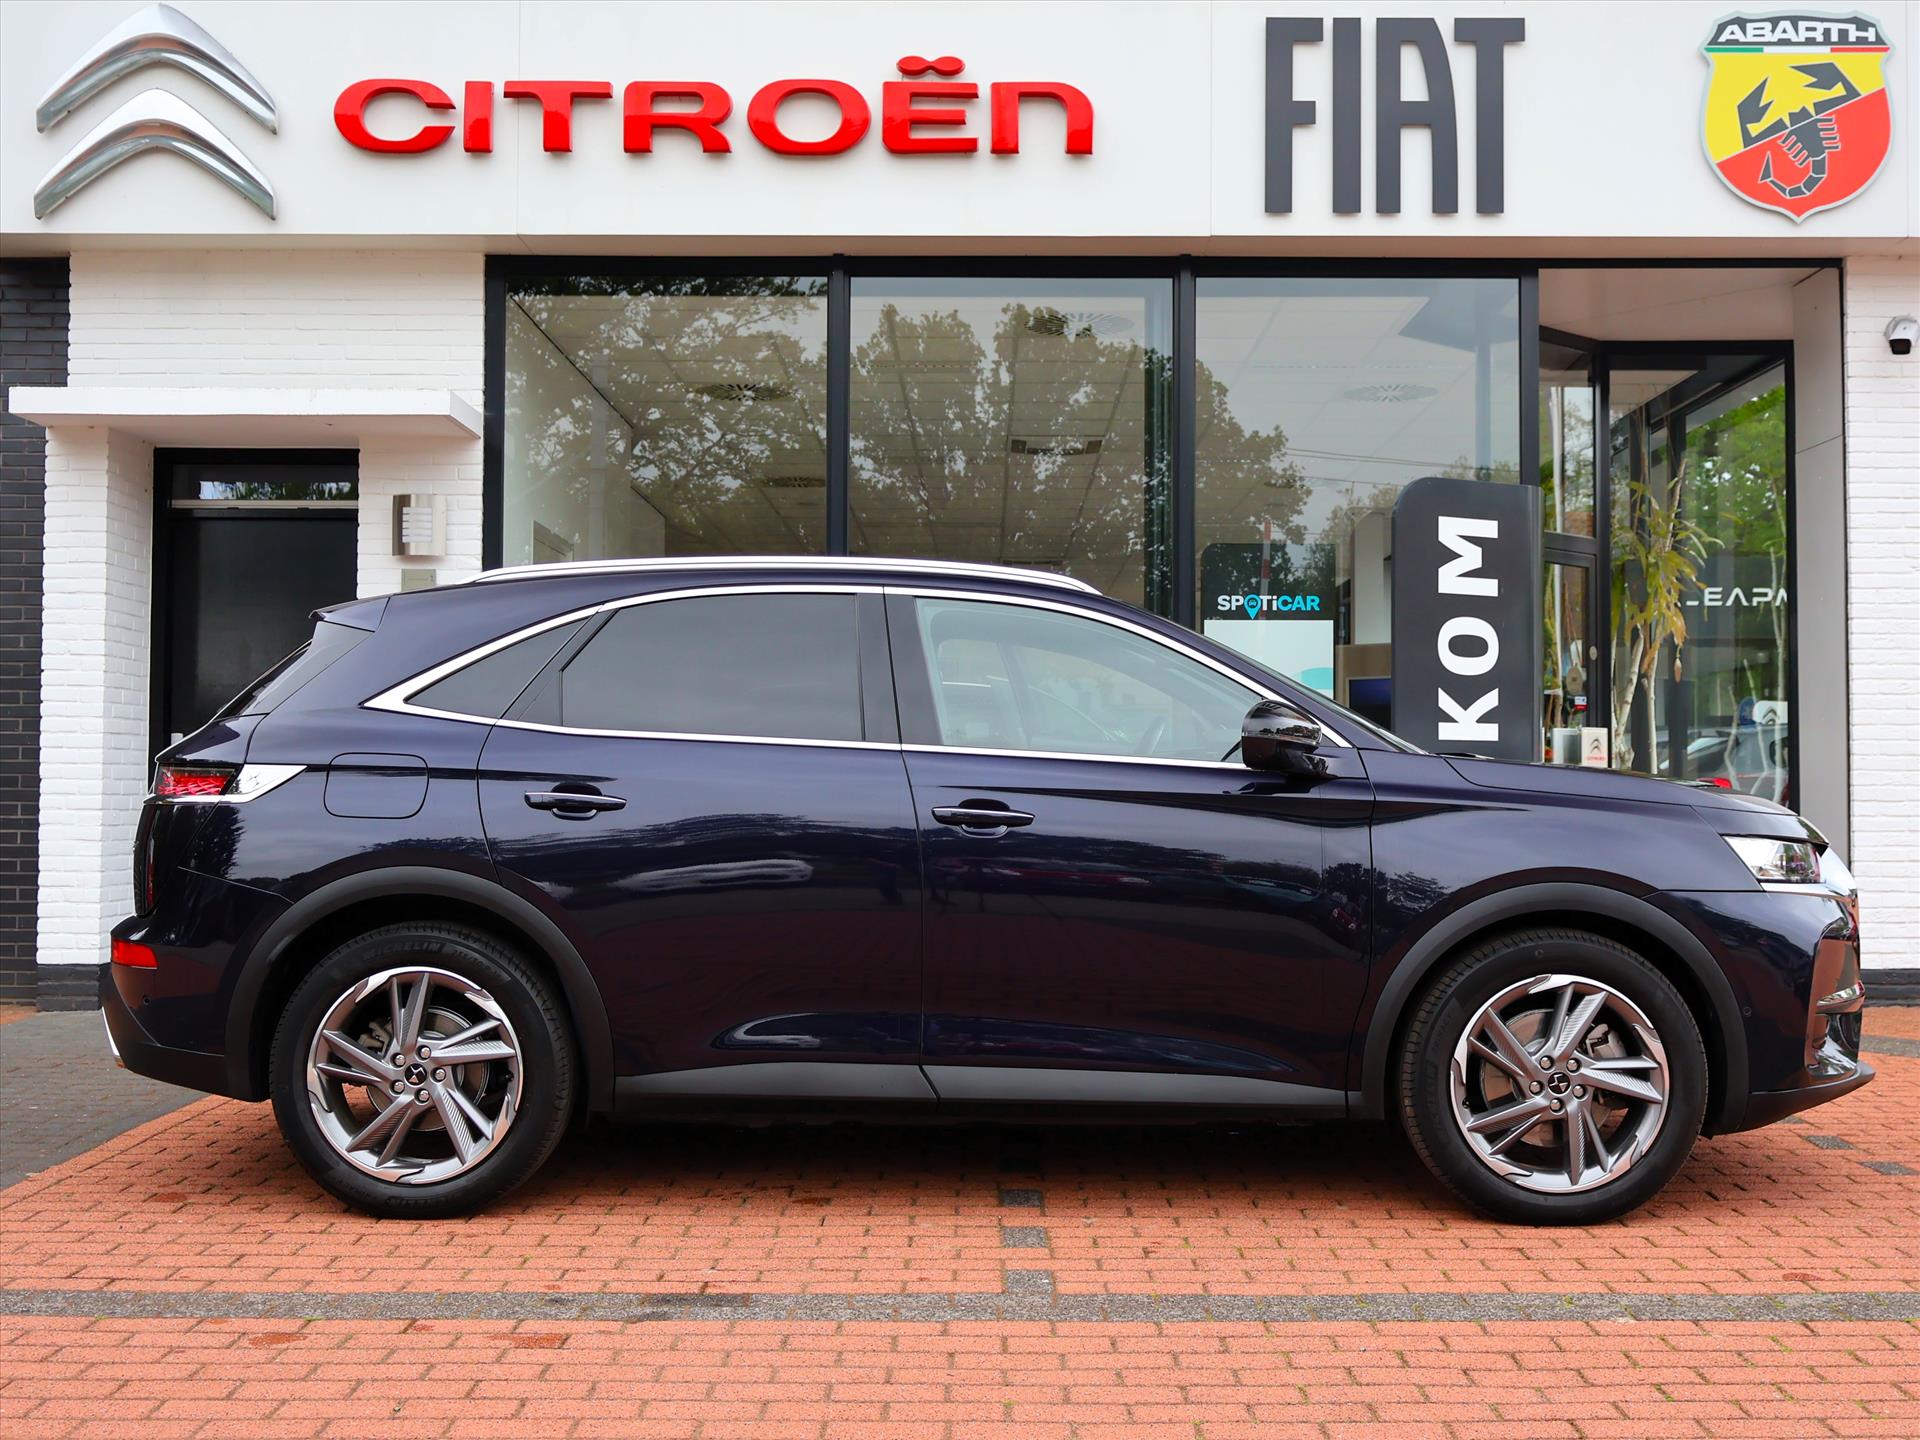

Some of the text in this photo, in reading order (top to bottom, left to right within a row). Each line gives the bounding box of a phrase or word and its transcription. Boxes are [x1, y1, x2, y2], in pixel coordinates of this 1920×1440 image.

[1717, 20, 1876, 43] ABARTH
[333, 56, 1094, 156] CITROËN
[1265, 17, 1525, 213] FIAT
[1437, 515, 1500, 742] KOM
